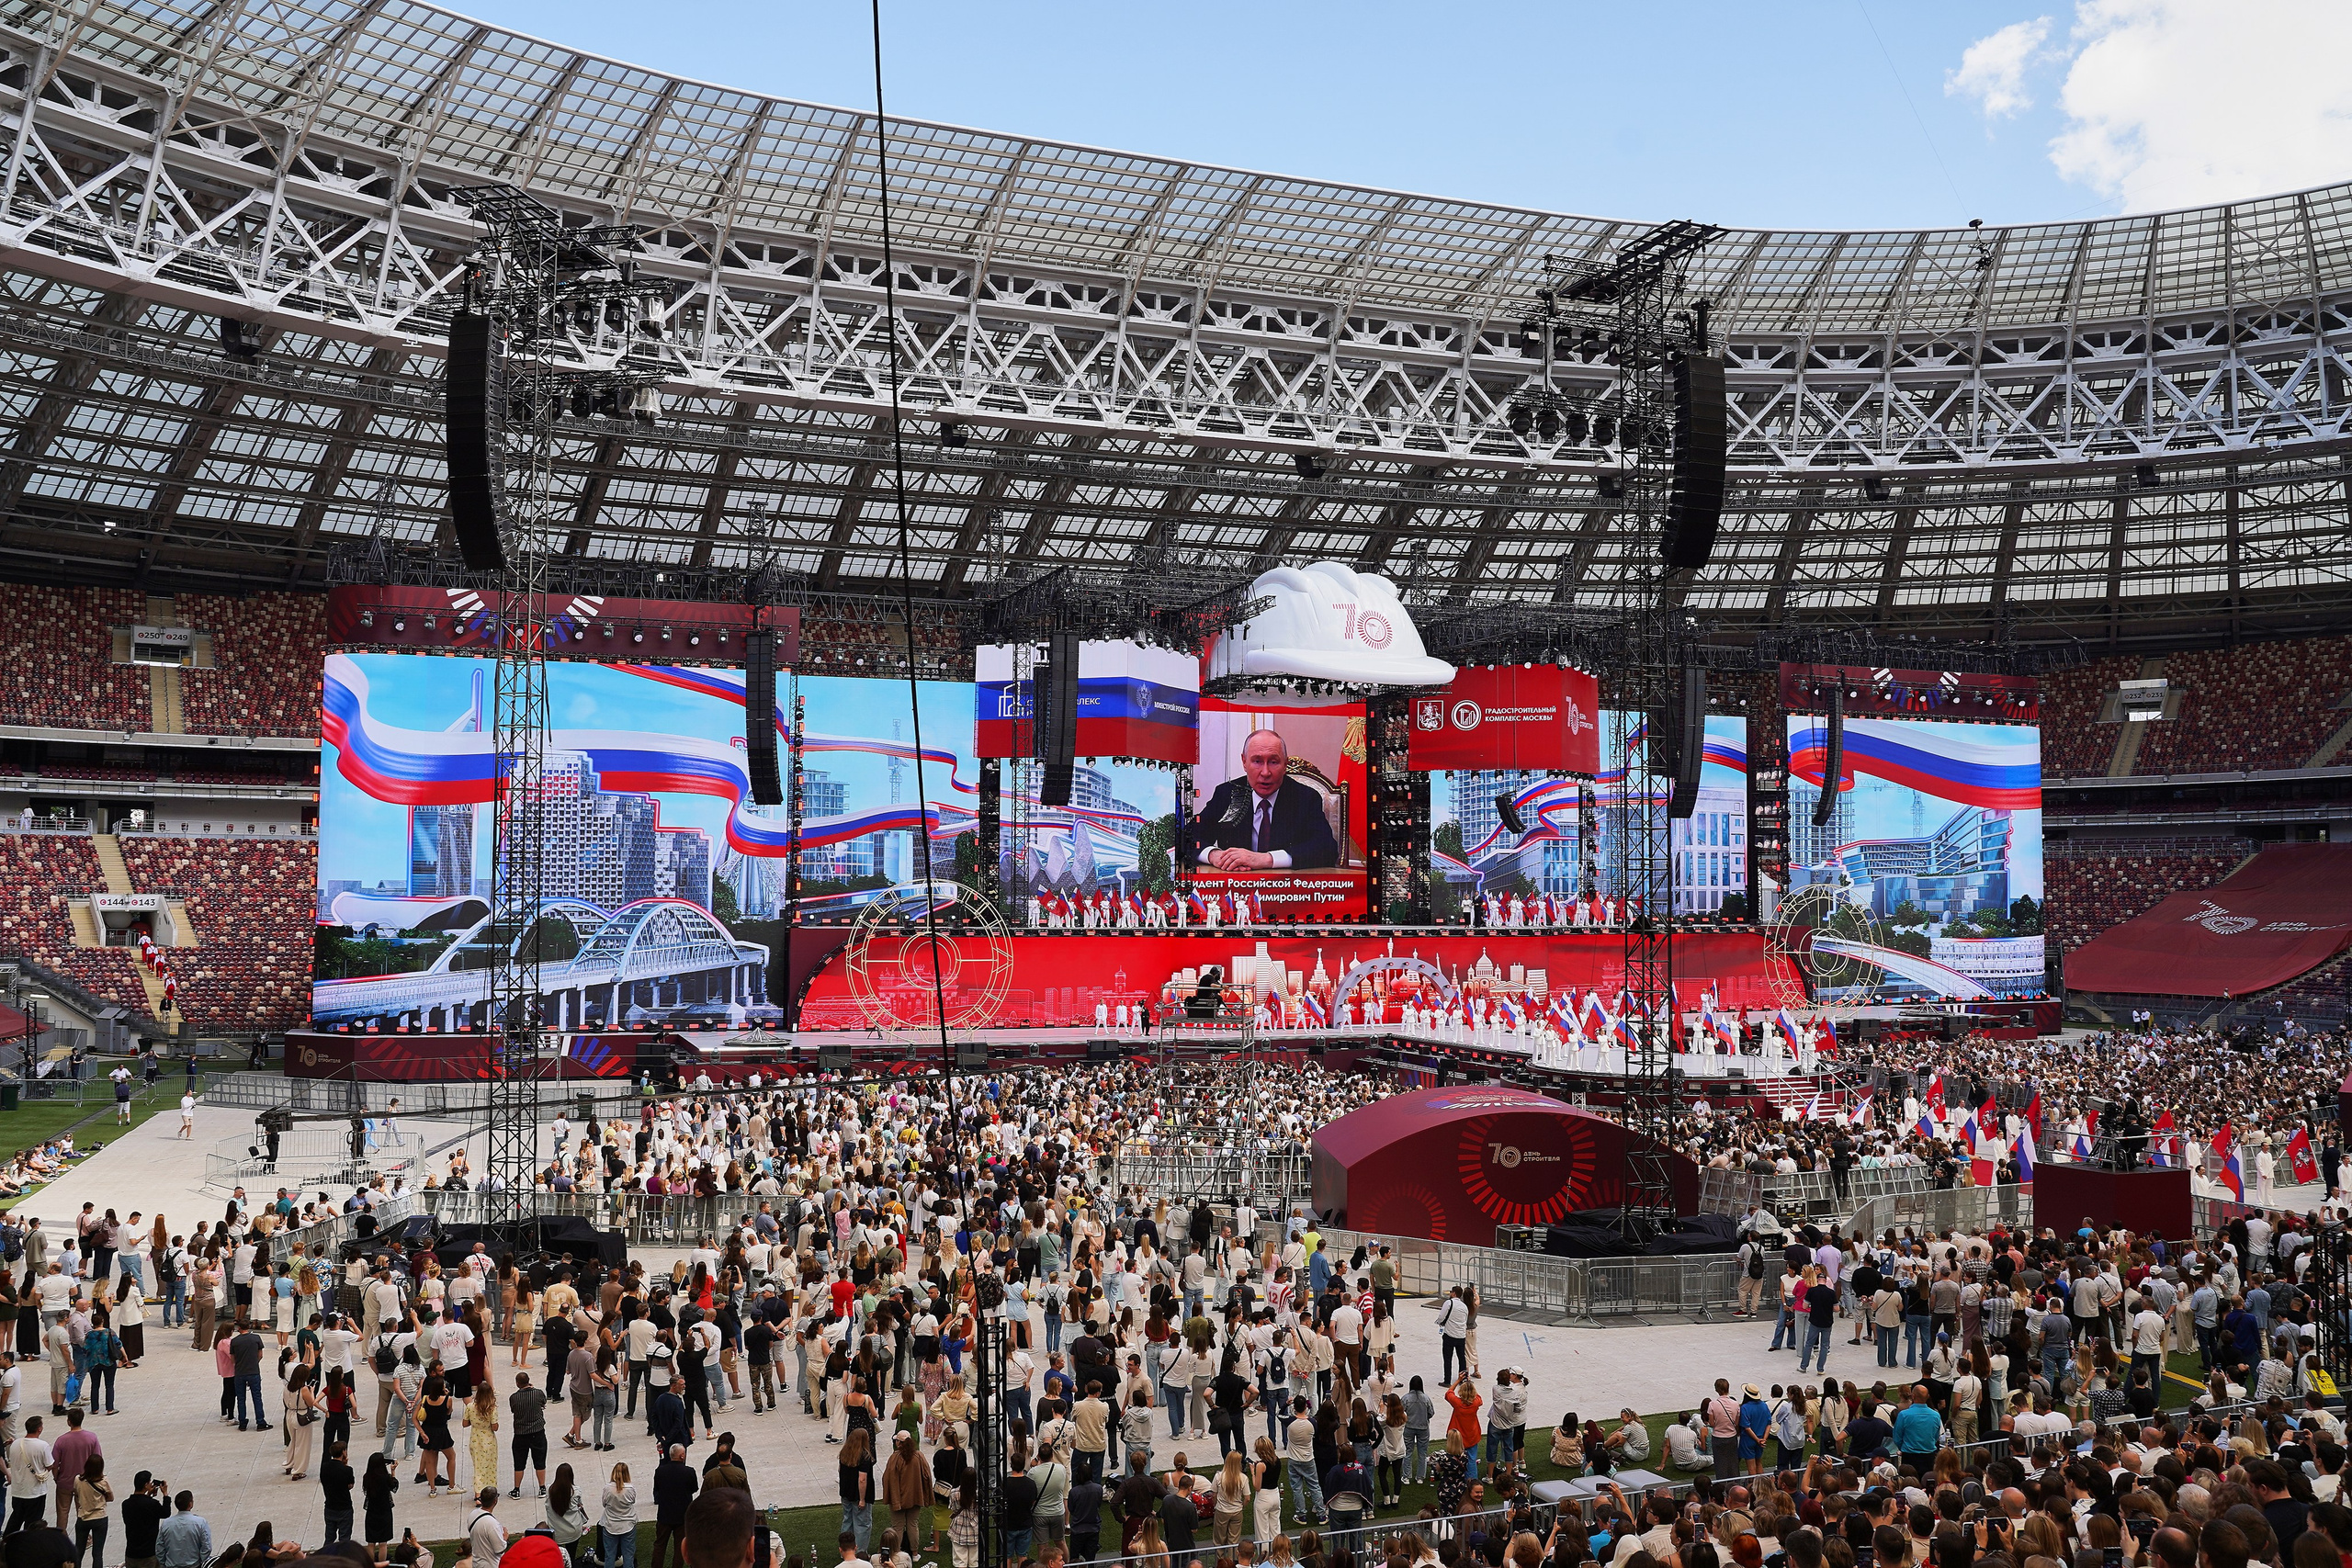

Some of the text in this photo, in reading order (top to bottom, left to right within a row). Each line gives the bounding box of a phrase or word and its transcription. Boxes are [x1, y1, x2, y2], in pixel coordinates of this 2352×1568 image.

[1076, 697, 1101, 705] ЛЕКС
[1485, 705, 1556, 714] ГРАДОСТРОИТЕЛЬНЫЙ
[1227, 878, 1291, 888] Российской
[1293, 878, 1354, 889] Федерации
[1314, 892, 1345, 902] Путин
[1488, 1143, 1521, 1168] 70
[1268, 1292, 1278, 1304] 12
